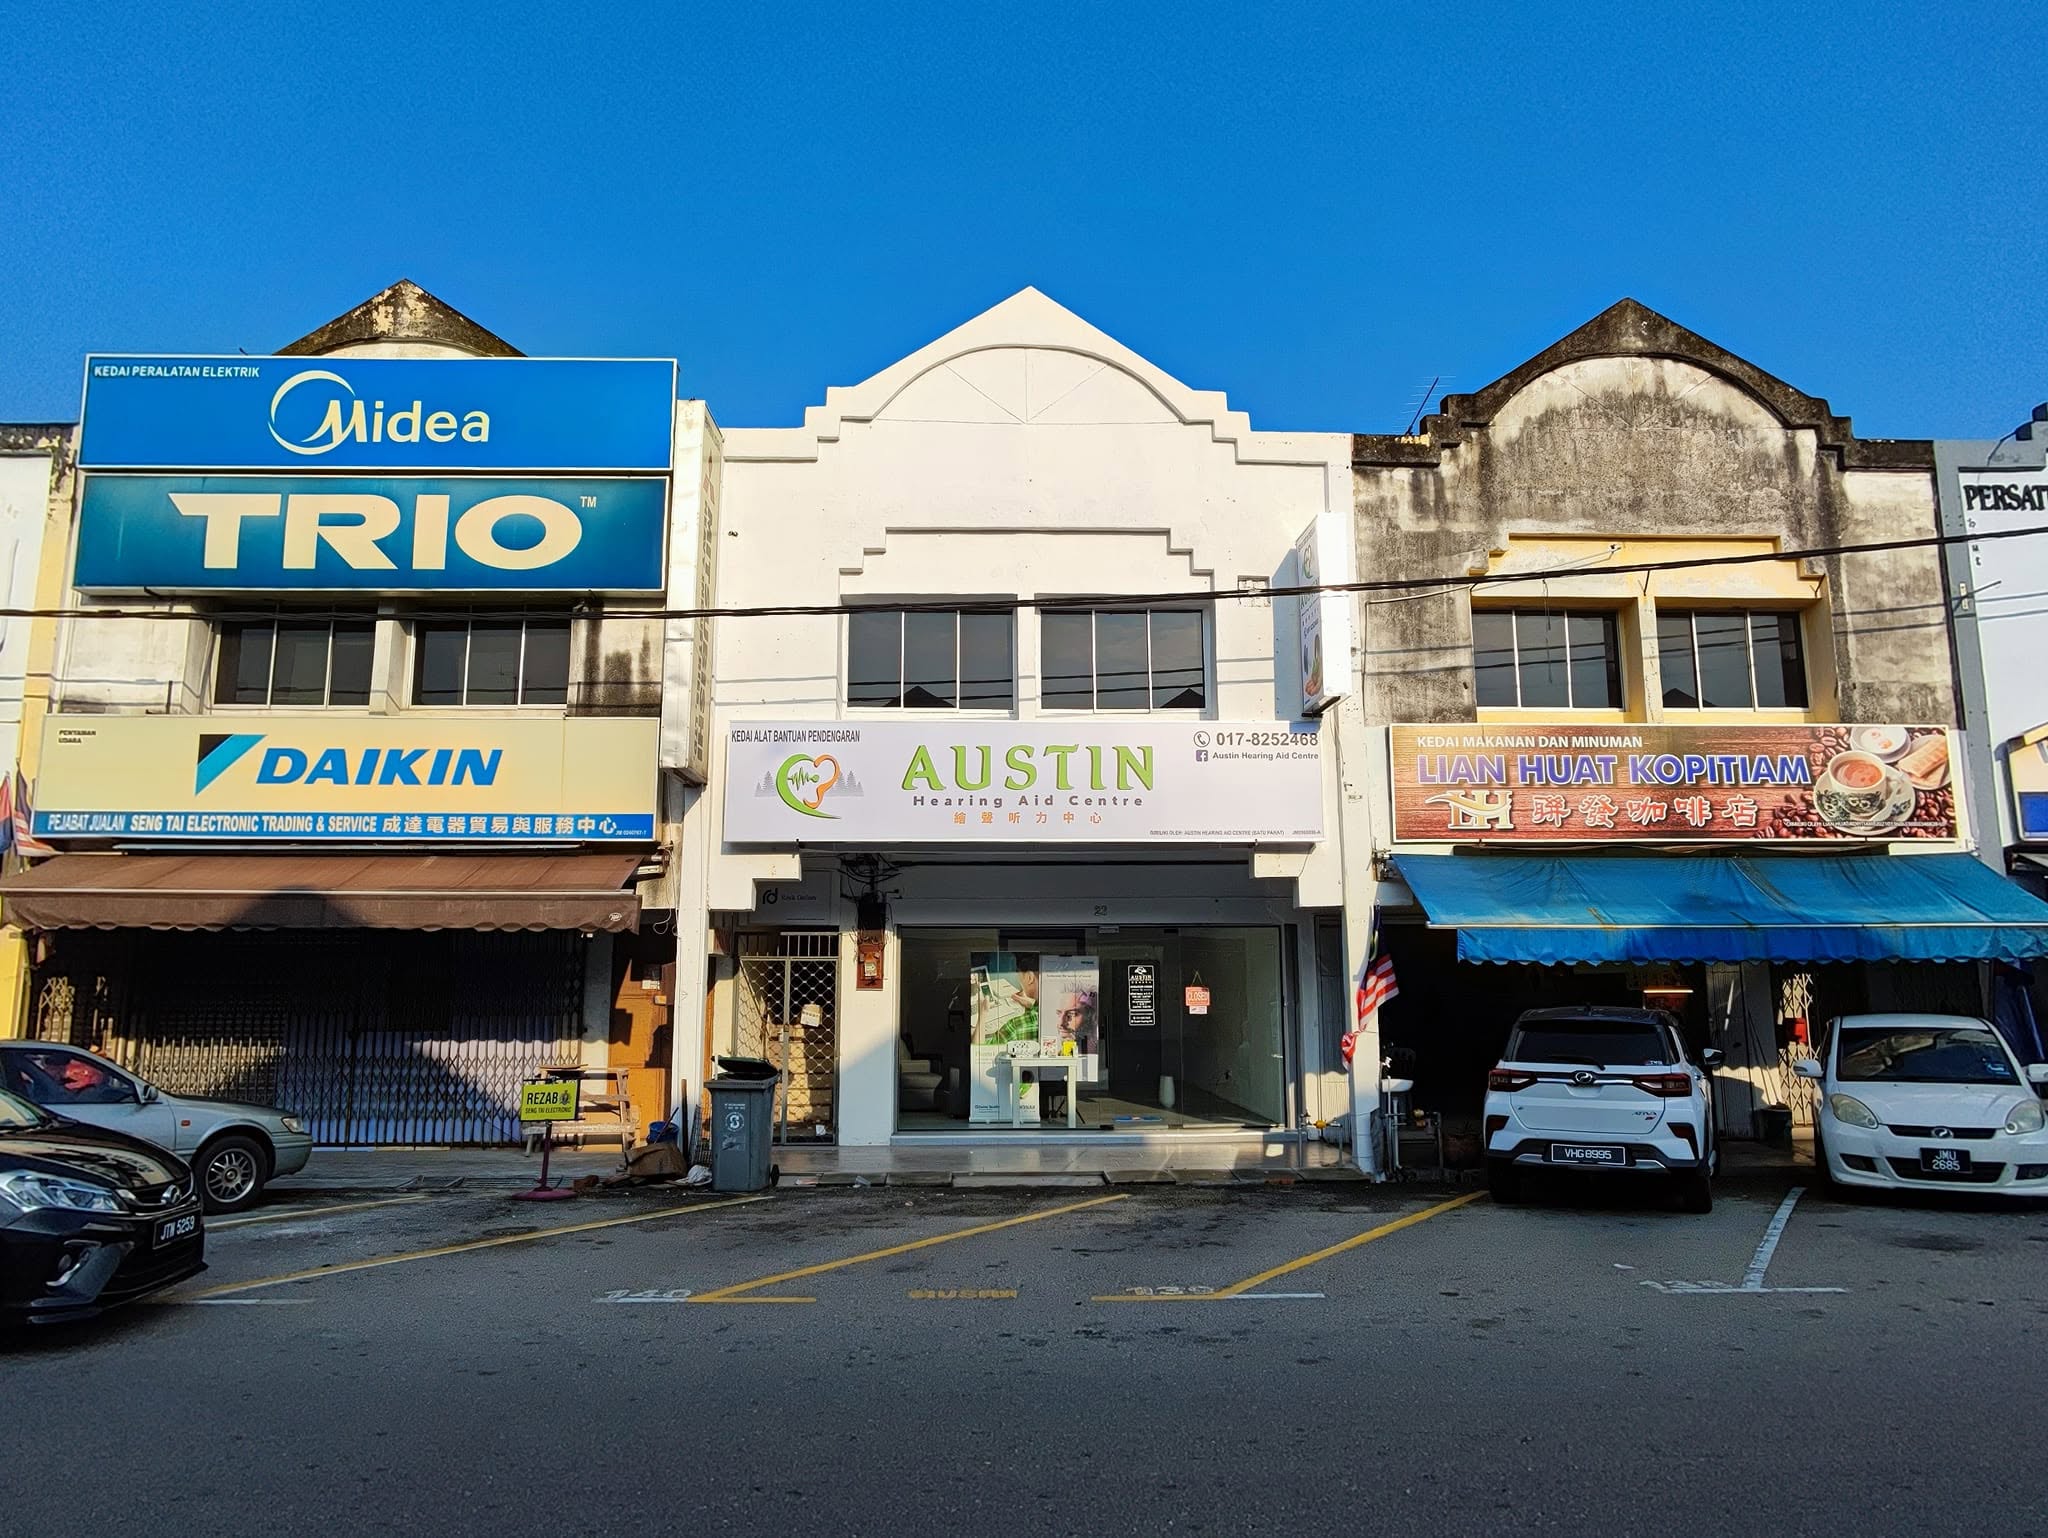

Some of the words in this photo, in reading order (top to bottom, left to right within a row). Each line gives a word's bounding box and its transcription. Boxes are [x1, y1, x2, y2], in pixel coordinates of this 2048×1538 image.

[94, 366, 130, 376] KEDAI
[131, 366, 199, 377] PERALATAN
[202, 367, 260, 377] ELEKTRIK
[300, 399, 490, 445] Midea
[168, 493, 583, 571] TRIO
[579, 496, 597, 509] TM
[731, 730, 753, 743] KEDAI
[754, 730, 773, 743] ALAT
[773, 730, 807, 743] BANTUAN
[808, 730, 861, 743] PENDENGARAN
[1216, 732, 1319, 746] 017-8252468
[1417, 736, 1460, 748] KEDAI
[1463, 736, 1536, 748] MAKANAN
[1538, 736, 1569, 748] DAN
[1571, 736, 1643, 748] MINUMAN
[1212, 752, 1240, 760] Austin
[1241, 752, 1274, 761] Hearing
[1275, 752, 1290, 760] Aid
[1291, 752, 1319, 760] Centre
[256, 748, 503, 786] DAIKIN
[901, 744, 1154, 791] AUSTIN
[1417, 754, 1506, 785] LIAN
[1517, 754, 1618, 785] HUAT
[1628, 754, 1812, 785] KOPITIAM
[913, 795, 1003, 809] Hearing
[1018, 795, 1054, 806] Aid
[1068, 795, 1144, 806] Centre
[48, 814, 89, 831] PEJABAT
[89, 814, 126, 831] JUALAN
[130, 814, 164, 832] SENG
[165, 815, 184, 832] TAI
[186, 815, 259, 832] ELECTRONIC
[261, 815, 313, 833] TRADING
[315, 816, 325, 832] &
[327, 816, 378, 833] SERVICE
[382, 816, 617, 835] 成達電器貿易與服務中心
[526, 1092, 559, 1105] REZAB
[545, 1106, 572, 1114] ELECTRONIC
[1564, 1148, 1585, 1158] VHG
[1585, 1149, 1612, 1160] 8995
[1935, 1150, 1957, 1161] JMU
[1931, 1159, 1961, 1171] 2685
[176, 1215, 195, 1235] 5259
